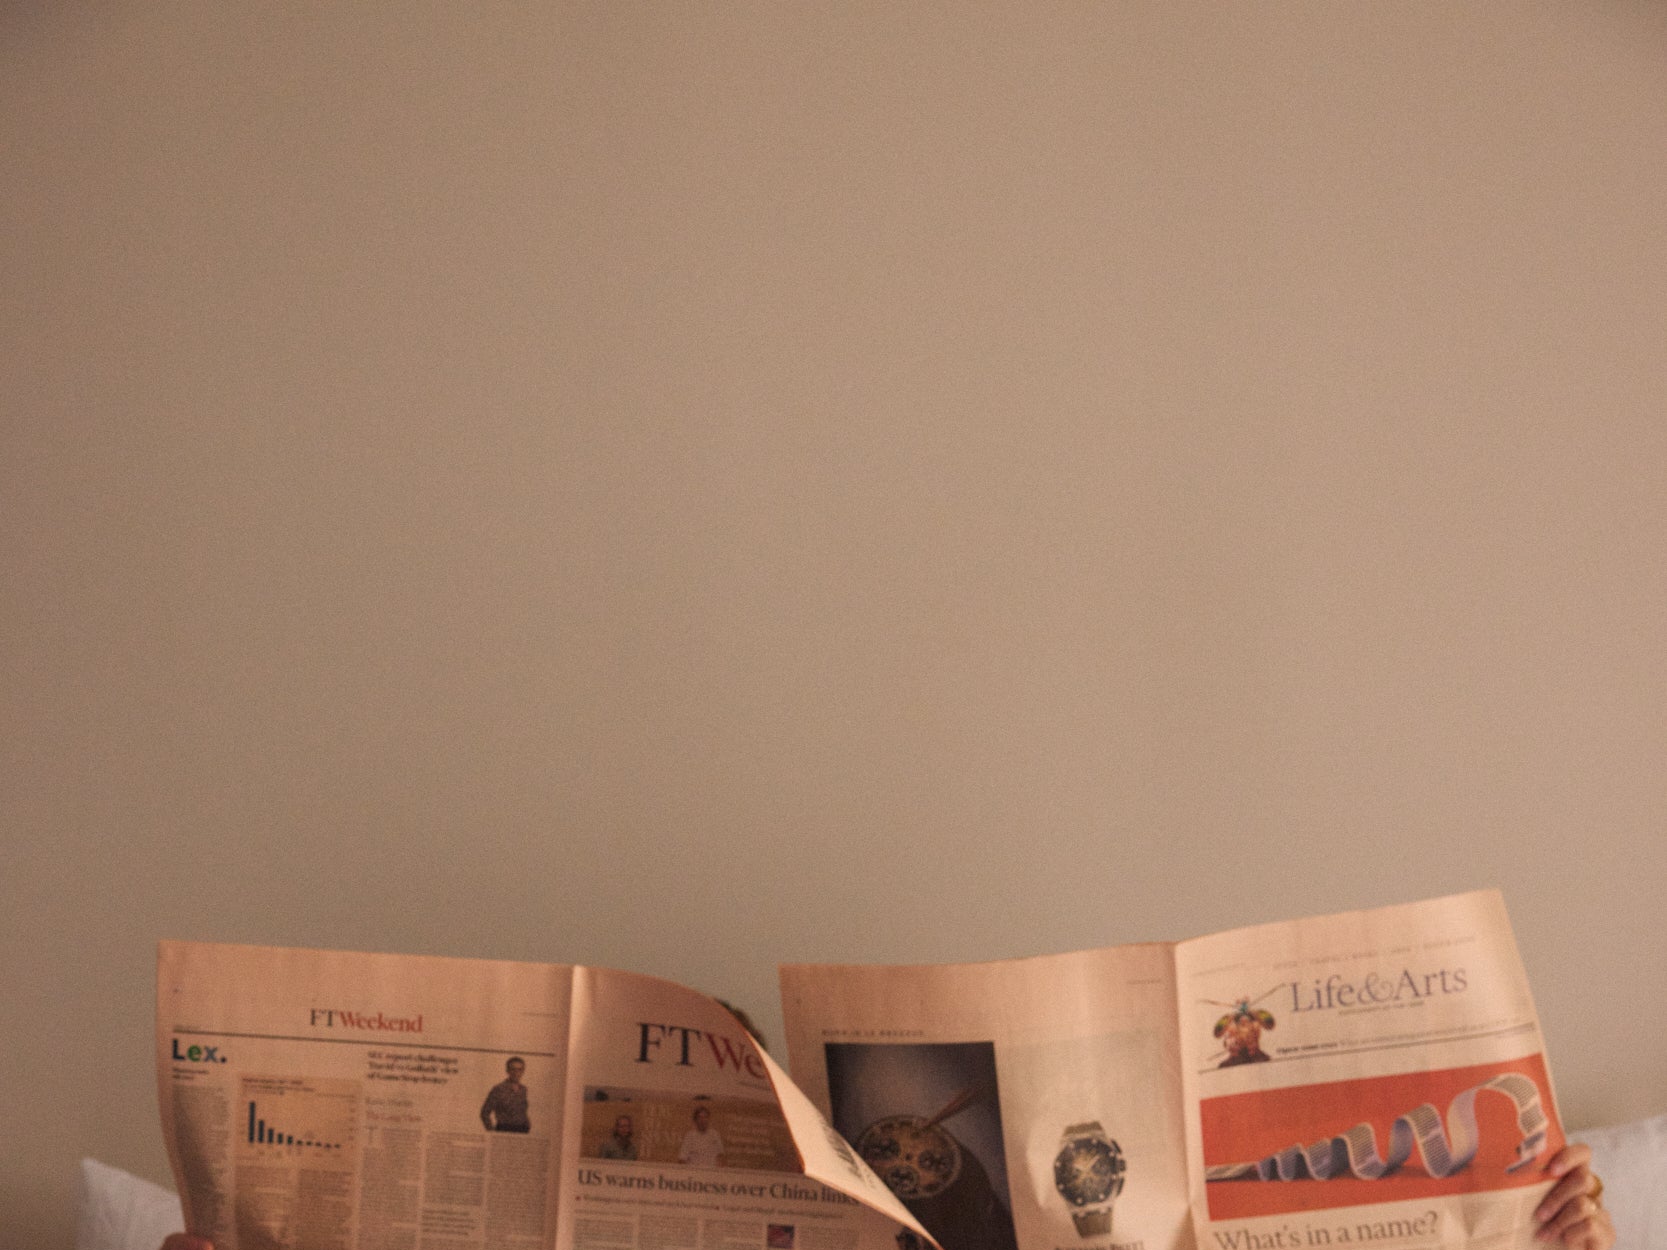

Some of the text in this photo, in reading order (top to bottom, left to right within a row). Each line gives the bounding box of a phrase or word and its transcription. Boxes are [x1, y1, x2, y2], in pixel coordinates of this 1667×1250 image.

[1290, 967, 1468, 1013] Life&Arts
[309, 1008, 424, 1033] FTWeekend
[172, 1039, 227, 1063] Lex.
[577, 1169, 602, 1186] US
[605, 1174, 655, 1189] warns
[659, 1175, 730, 1196] business
[730, 1184, 766, 1197] over
[769, 1182, 818, 1201] China
[1308, 1224, 1332, 1247] in
[1336, 1227, 1354, 1244] a
[1357, 1210, 1440, 1243] name?
